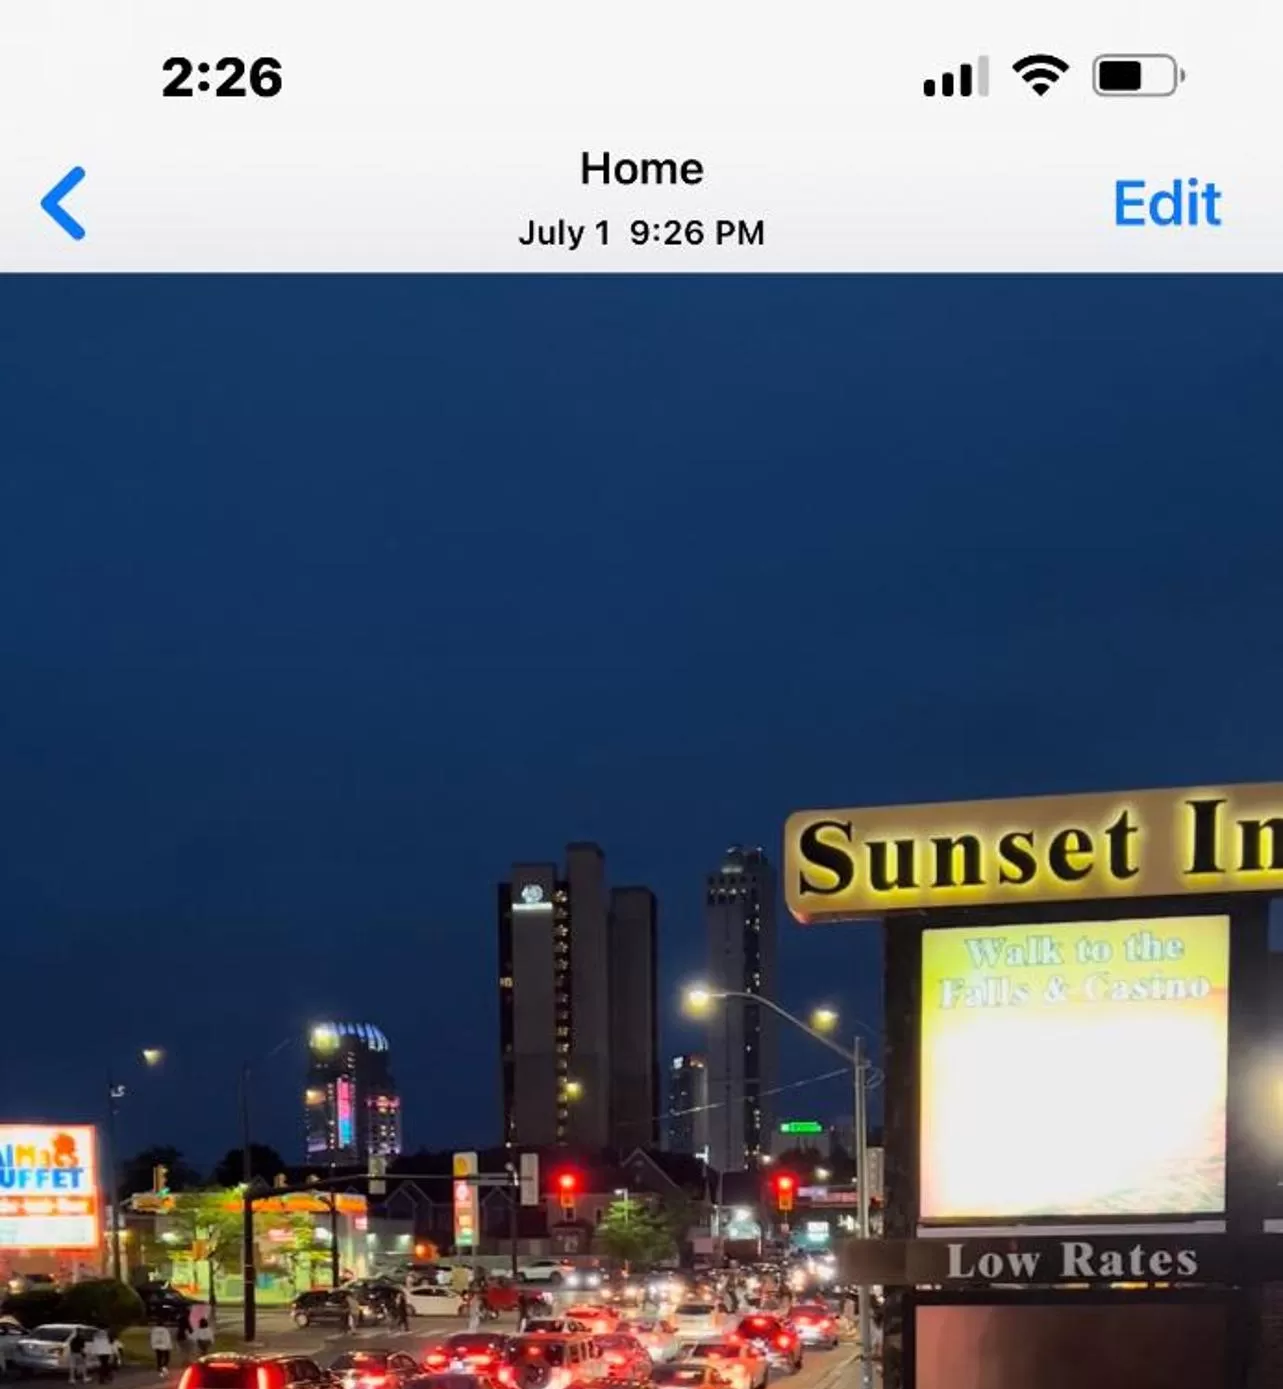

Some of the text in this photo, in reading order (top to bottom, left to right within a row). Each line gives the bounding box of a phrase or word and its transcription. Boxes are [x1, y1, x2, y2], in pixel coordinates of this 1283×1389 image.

[799, 810, 1140, 895] Sunset
[965, 931, 1185, 969] Walk to the
[940, 970, 1211, 1009] Falls & Casino
[947, 1242, 1199, 1279] Low Rates
